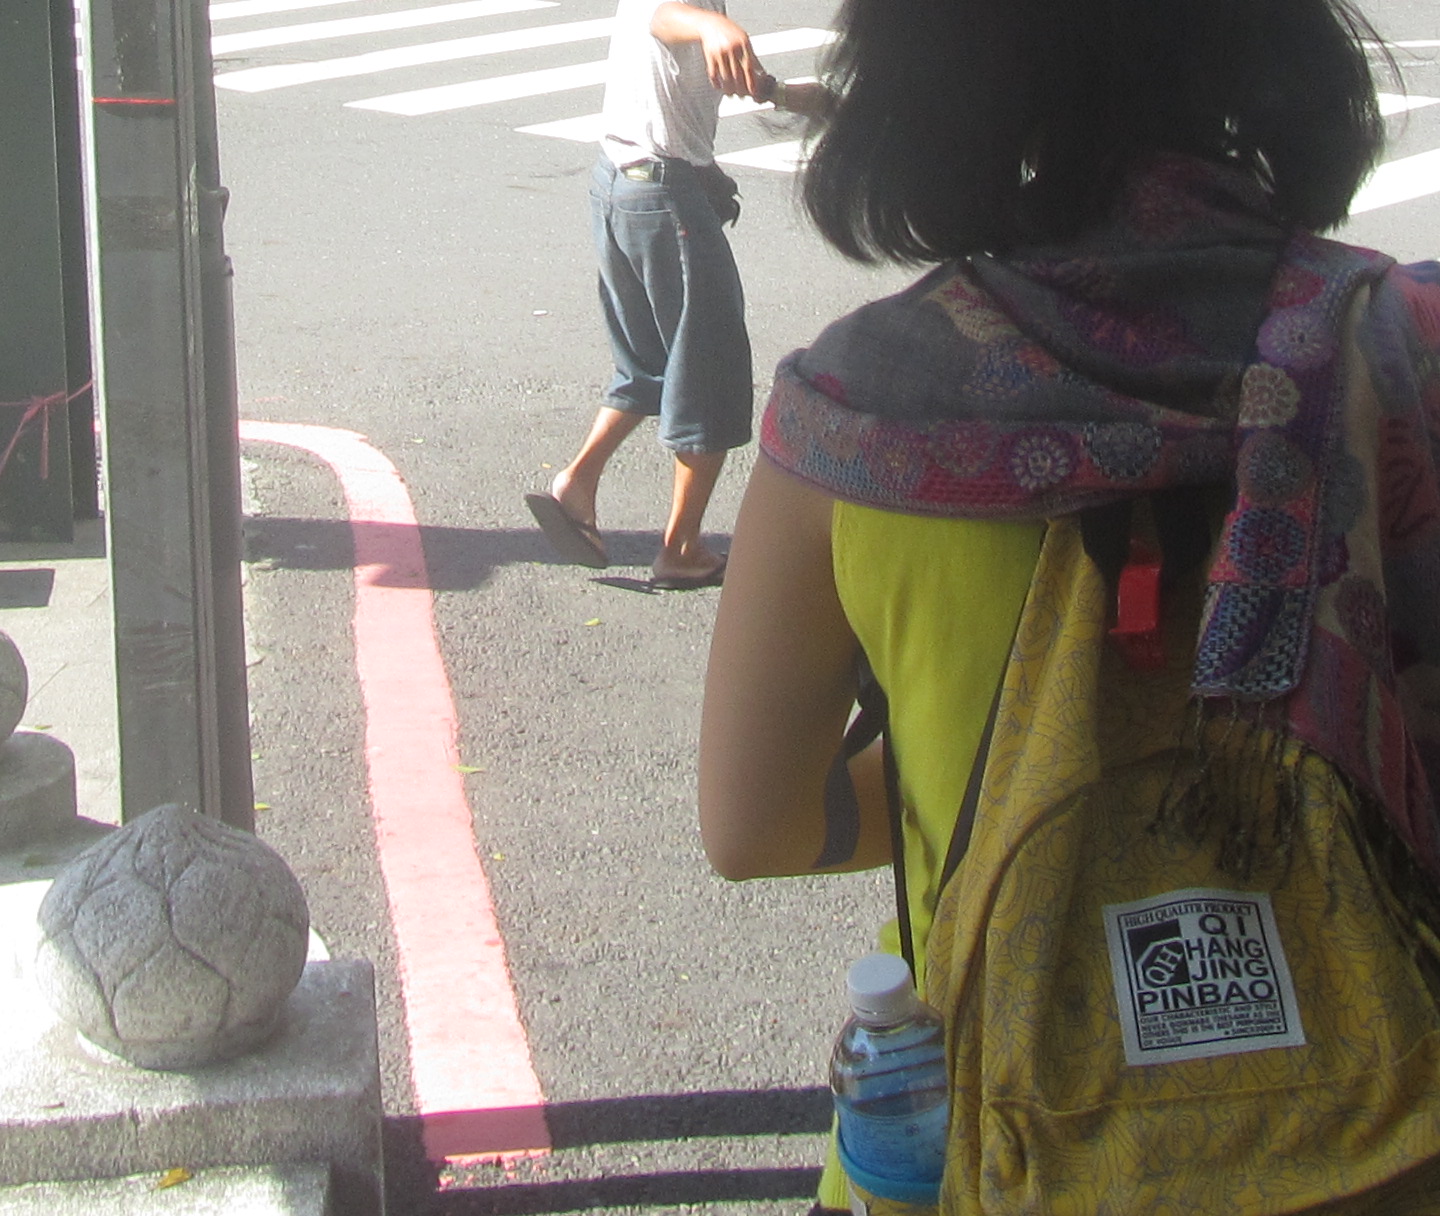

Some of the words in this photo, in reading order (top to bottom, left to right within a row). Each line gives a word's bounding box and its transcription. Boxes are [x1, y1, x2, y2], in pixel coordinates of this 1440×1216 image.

[1125, 913, 1154, 927] HIGH
[1205, 903, 1251, 915] PRODUCT
[1186, 937, 1265, 960] HANG
[1146, 945, 1184, 985] QH
[1191, 959, 1269, 981] JING
[1137, 979, 1274, 1013] PINBAO
